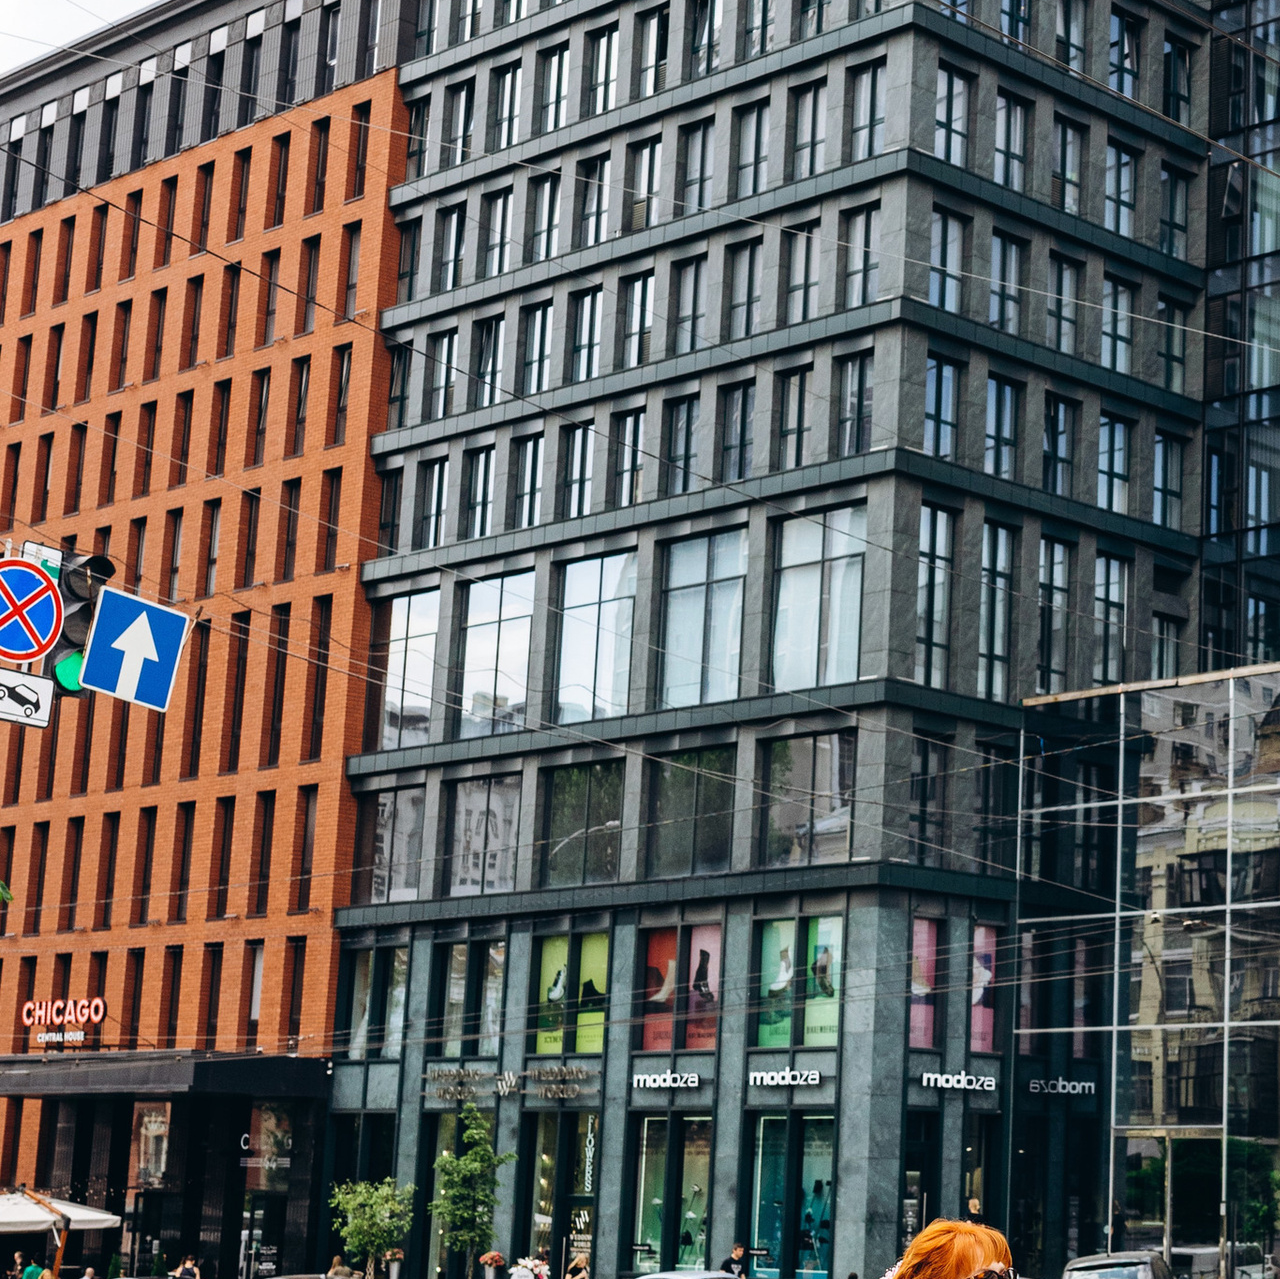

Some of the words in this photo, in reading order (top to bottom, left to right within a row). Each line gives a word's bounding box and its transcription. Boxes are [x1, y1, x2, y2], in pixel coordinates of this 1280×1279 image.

[22, 997, 104, 1027] CHICAGO
[37, 1032, 63, 1043] CENTRAL
[64, 1031, 85, 1041] HOUSE
[633, 1069, 699, 1088] modoza
[749, 1066, 820, 1086] modoza
[922, 1070, 996, 1091] modoza
[584, 1114, 595, 1192] FLOWERS
